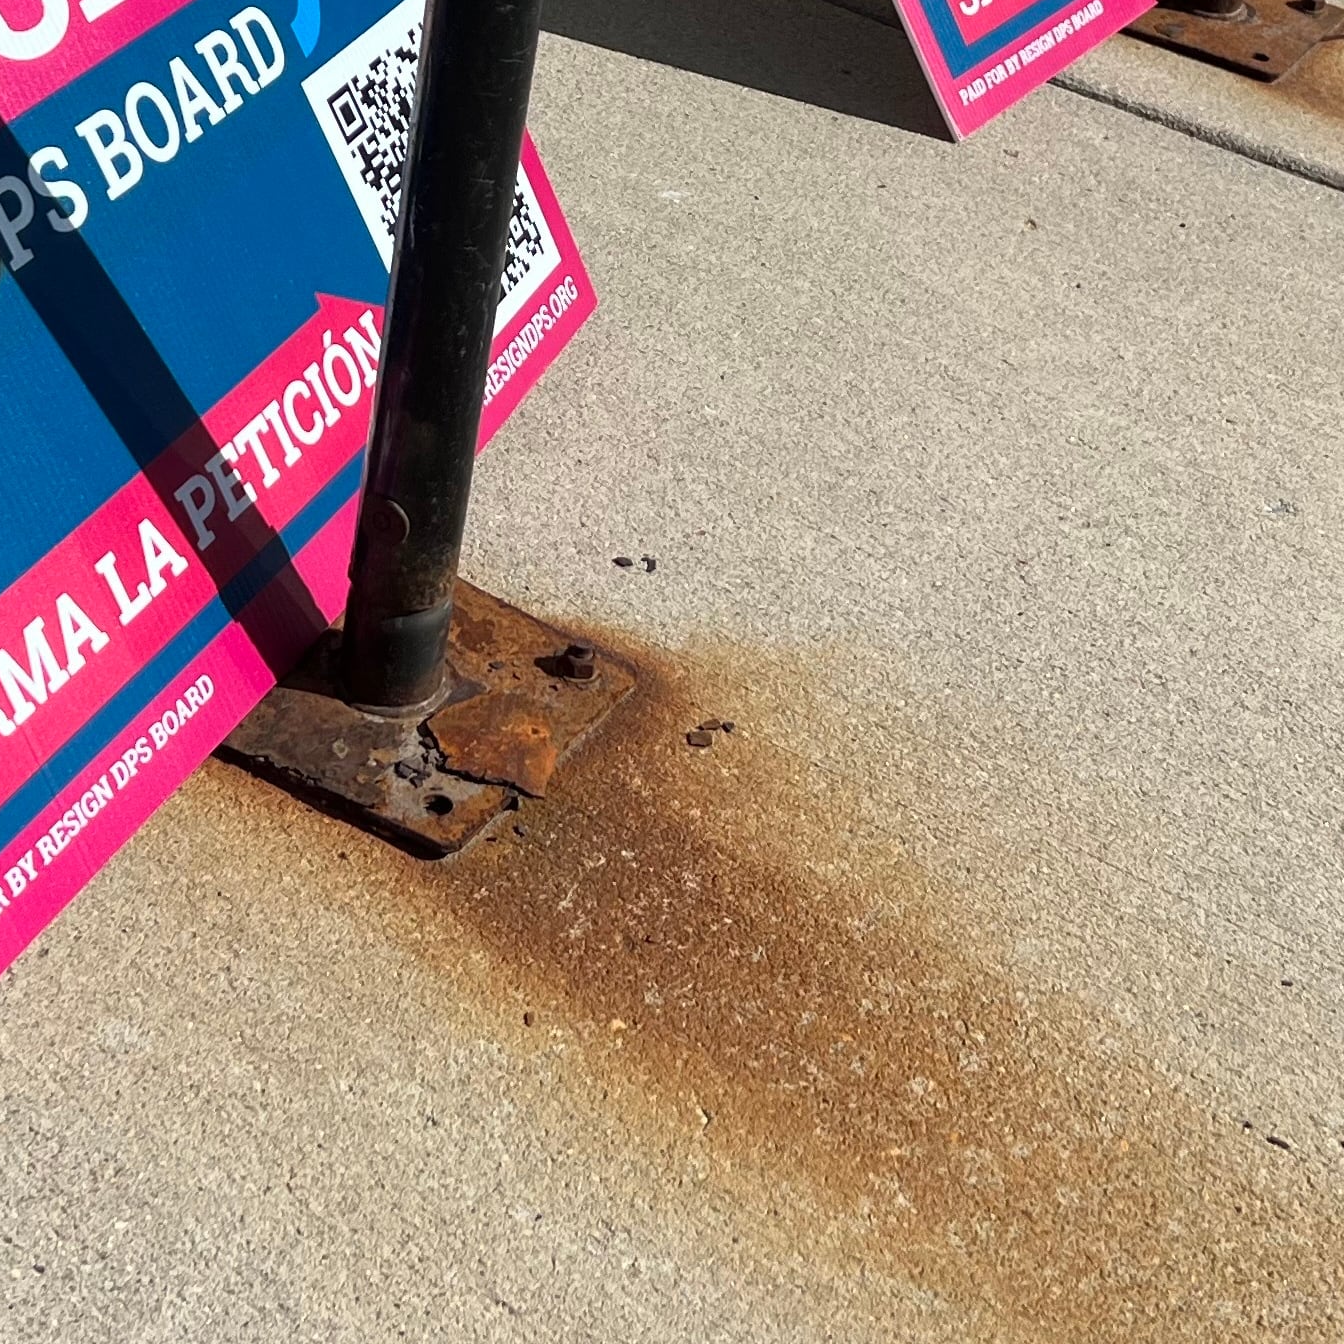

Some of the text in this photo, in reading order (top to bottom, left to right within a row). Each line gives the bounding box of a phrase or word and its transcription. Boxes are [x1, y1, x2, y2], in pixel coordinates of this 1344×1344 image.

[77, 5, 287, 203] BOARD
[958, 78, 987, 107] PAID
[983, 64, 1009, 90] FOR
[1004, 53, 1022, 76] BY
[1018, 30, 1057, 67] RESIGN
[1052, 18, 1074, 43] DPS
[95, 517, 190, 627] LA
[174, 309, 382, 552] PETICIÓN
[3, 849, 39, 898] BY
[35, 774, 115, 866] RESIGN
[109, 736, 154, 790] DPS
[147, 674, 216, 751] BOARD
